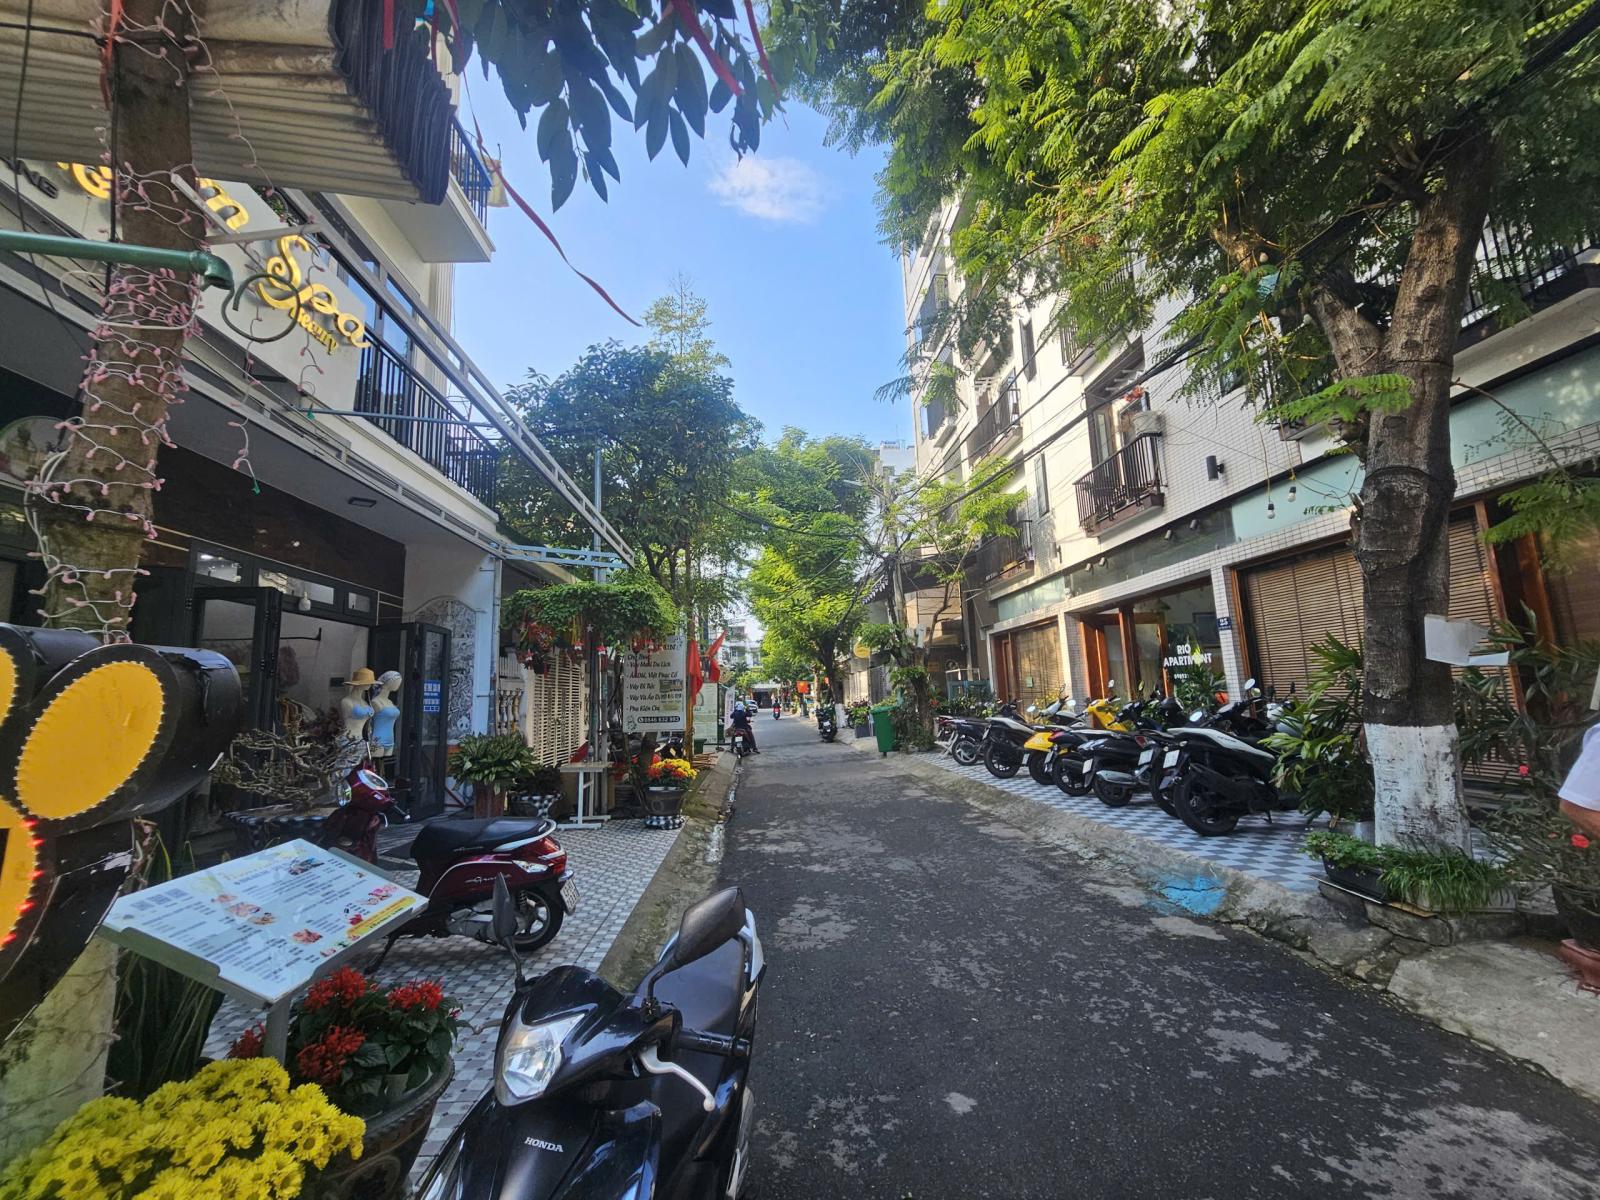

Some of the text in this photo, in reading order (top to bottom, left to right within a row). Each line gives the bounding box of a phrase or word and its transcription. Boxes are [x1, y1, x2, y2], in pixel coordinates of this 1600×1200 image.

[256, 234, 371, 348] Spa
[1177, 643, 1191, 655] RIO
[1164, 653, 1212, 667] APARTMNT
[524, 1136, 564, 1153] HONDA
